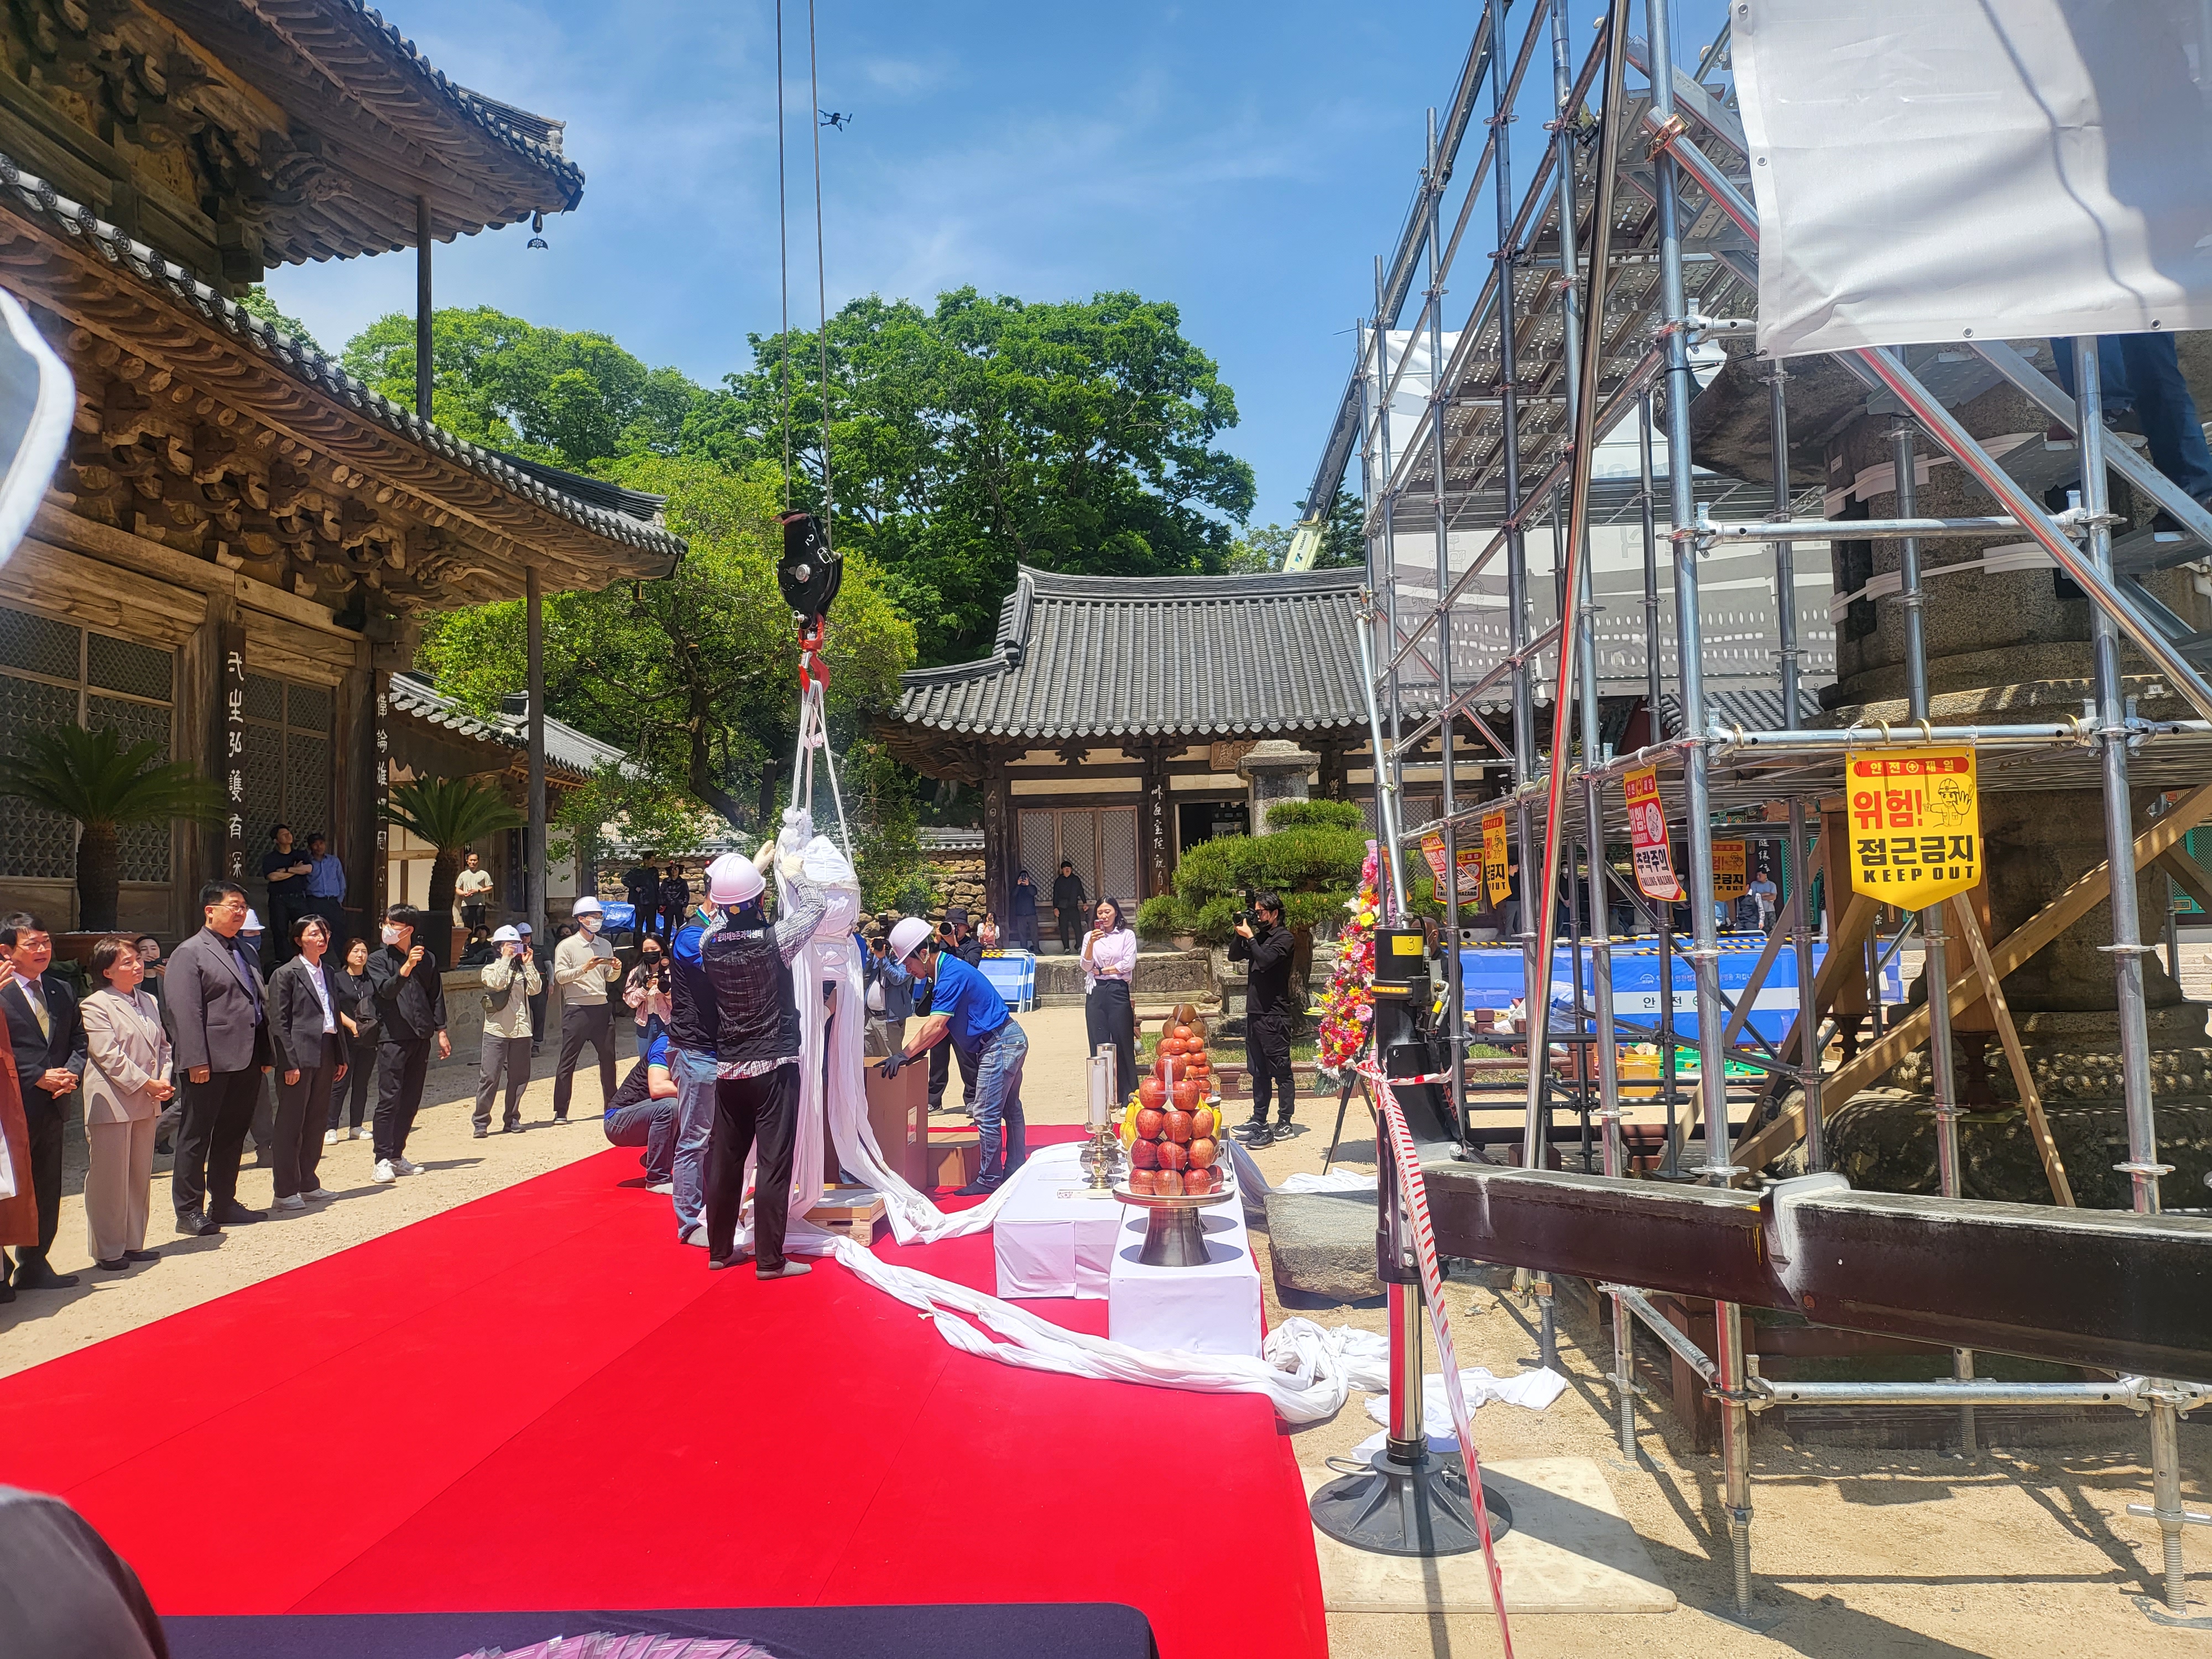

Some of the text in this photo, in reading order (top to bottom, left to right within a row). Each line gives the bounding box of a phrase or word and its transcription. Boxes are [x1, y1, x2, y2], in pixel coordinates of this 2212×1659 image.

[1299, 533, 1308, 550] TADANO
[1870, 759, 1954, 774] 안전 제일
[1853, 789, 1923, 829] 위험!
[1857, 835, 1974, 866] 접근금지
[1636, 849, 1670, 874] 추락주의
[1713, 855, 1724, 870] 험!
[1641, 875, 1675, 886] FALLING HAZARD
[1713, 874, 1743, 885] 근금지
[1863, 865, 1974, 883] KEEP OUT
[717, 929, 763, 942] 문화재보존과학센터
[1407, 937, 1415, 951] 3
